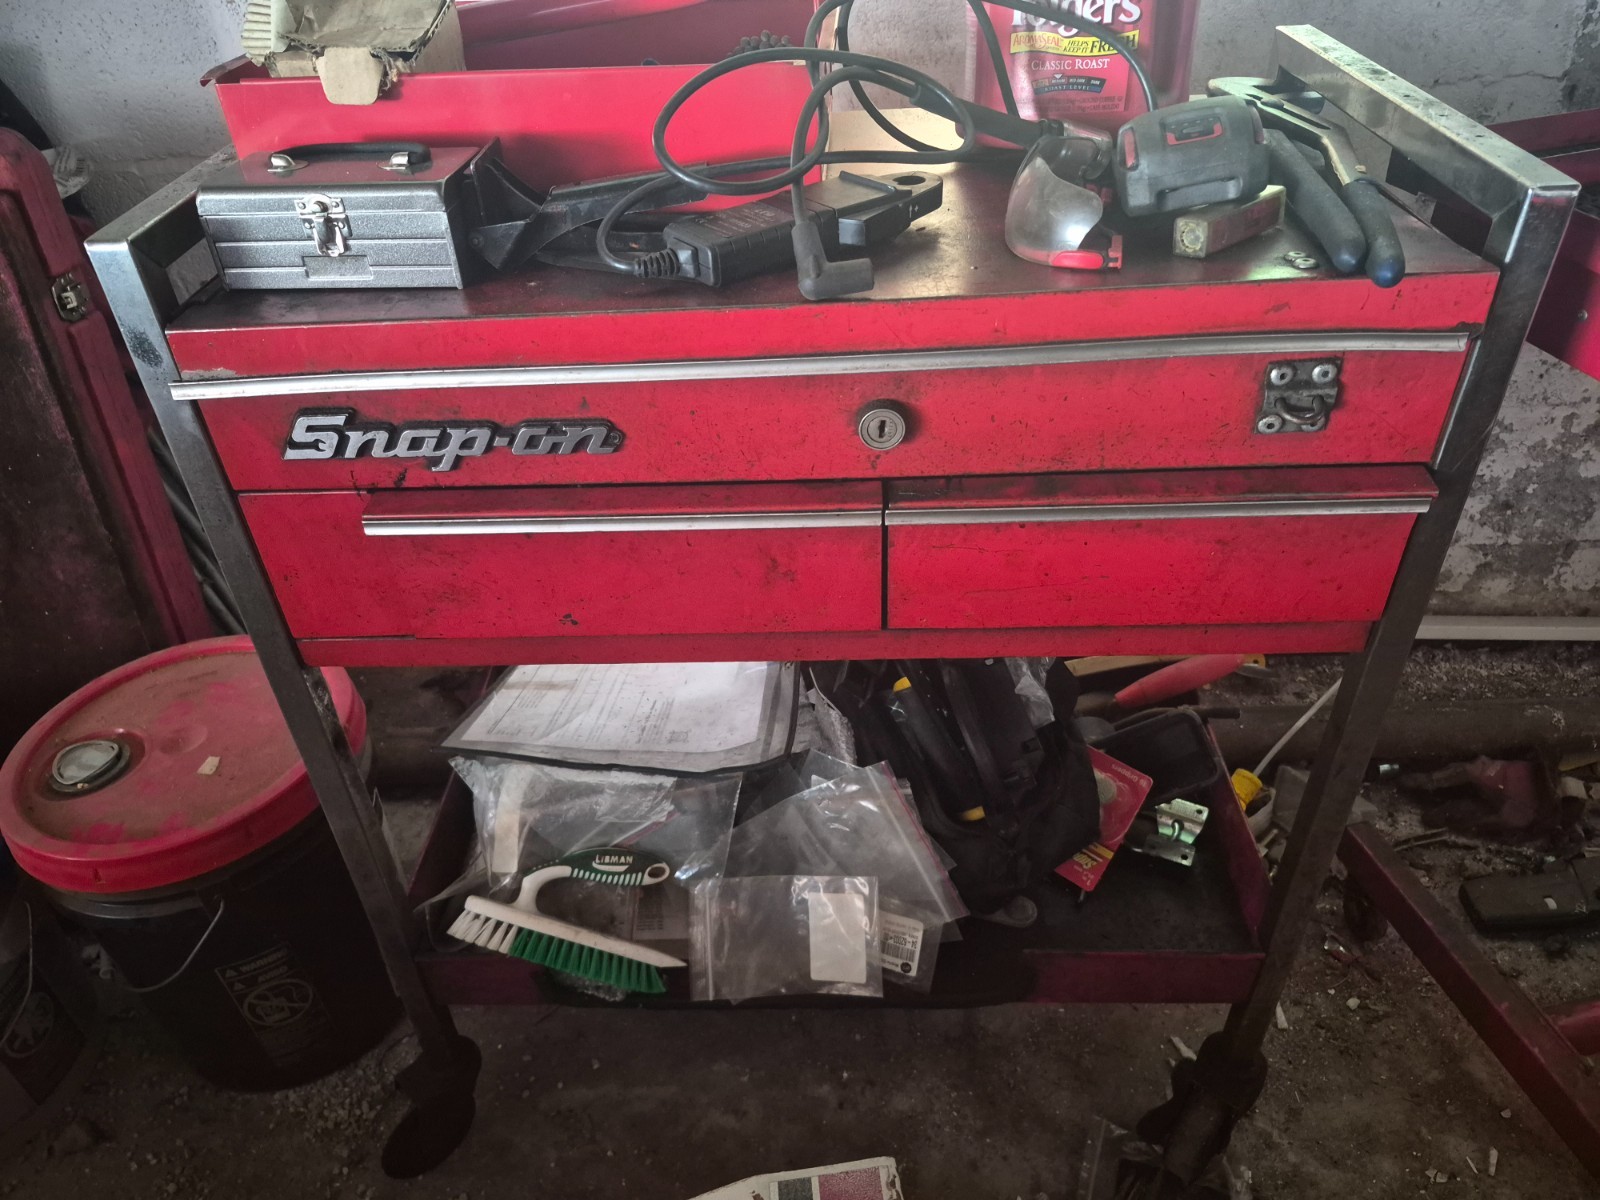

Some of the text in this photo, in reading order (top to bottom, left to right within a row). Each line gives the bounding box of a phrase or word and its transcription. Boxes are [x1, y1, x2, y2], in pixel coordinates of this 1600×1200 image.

[1090, 34, 1137, 53] FRH
[1031, 58, 1110, 70] CLASSIC ROAST
[284, 411, 618, 472] Snap-on
[595, 854, 634, 864] LIBMAN
